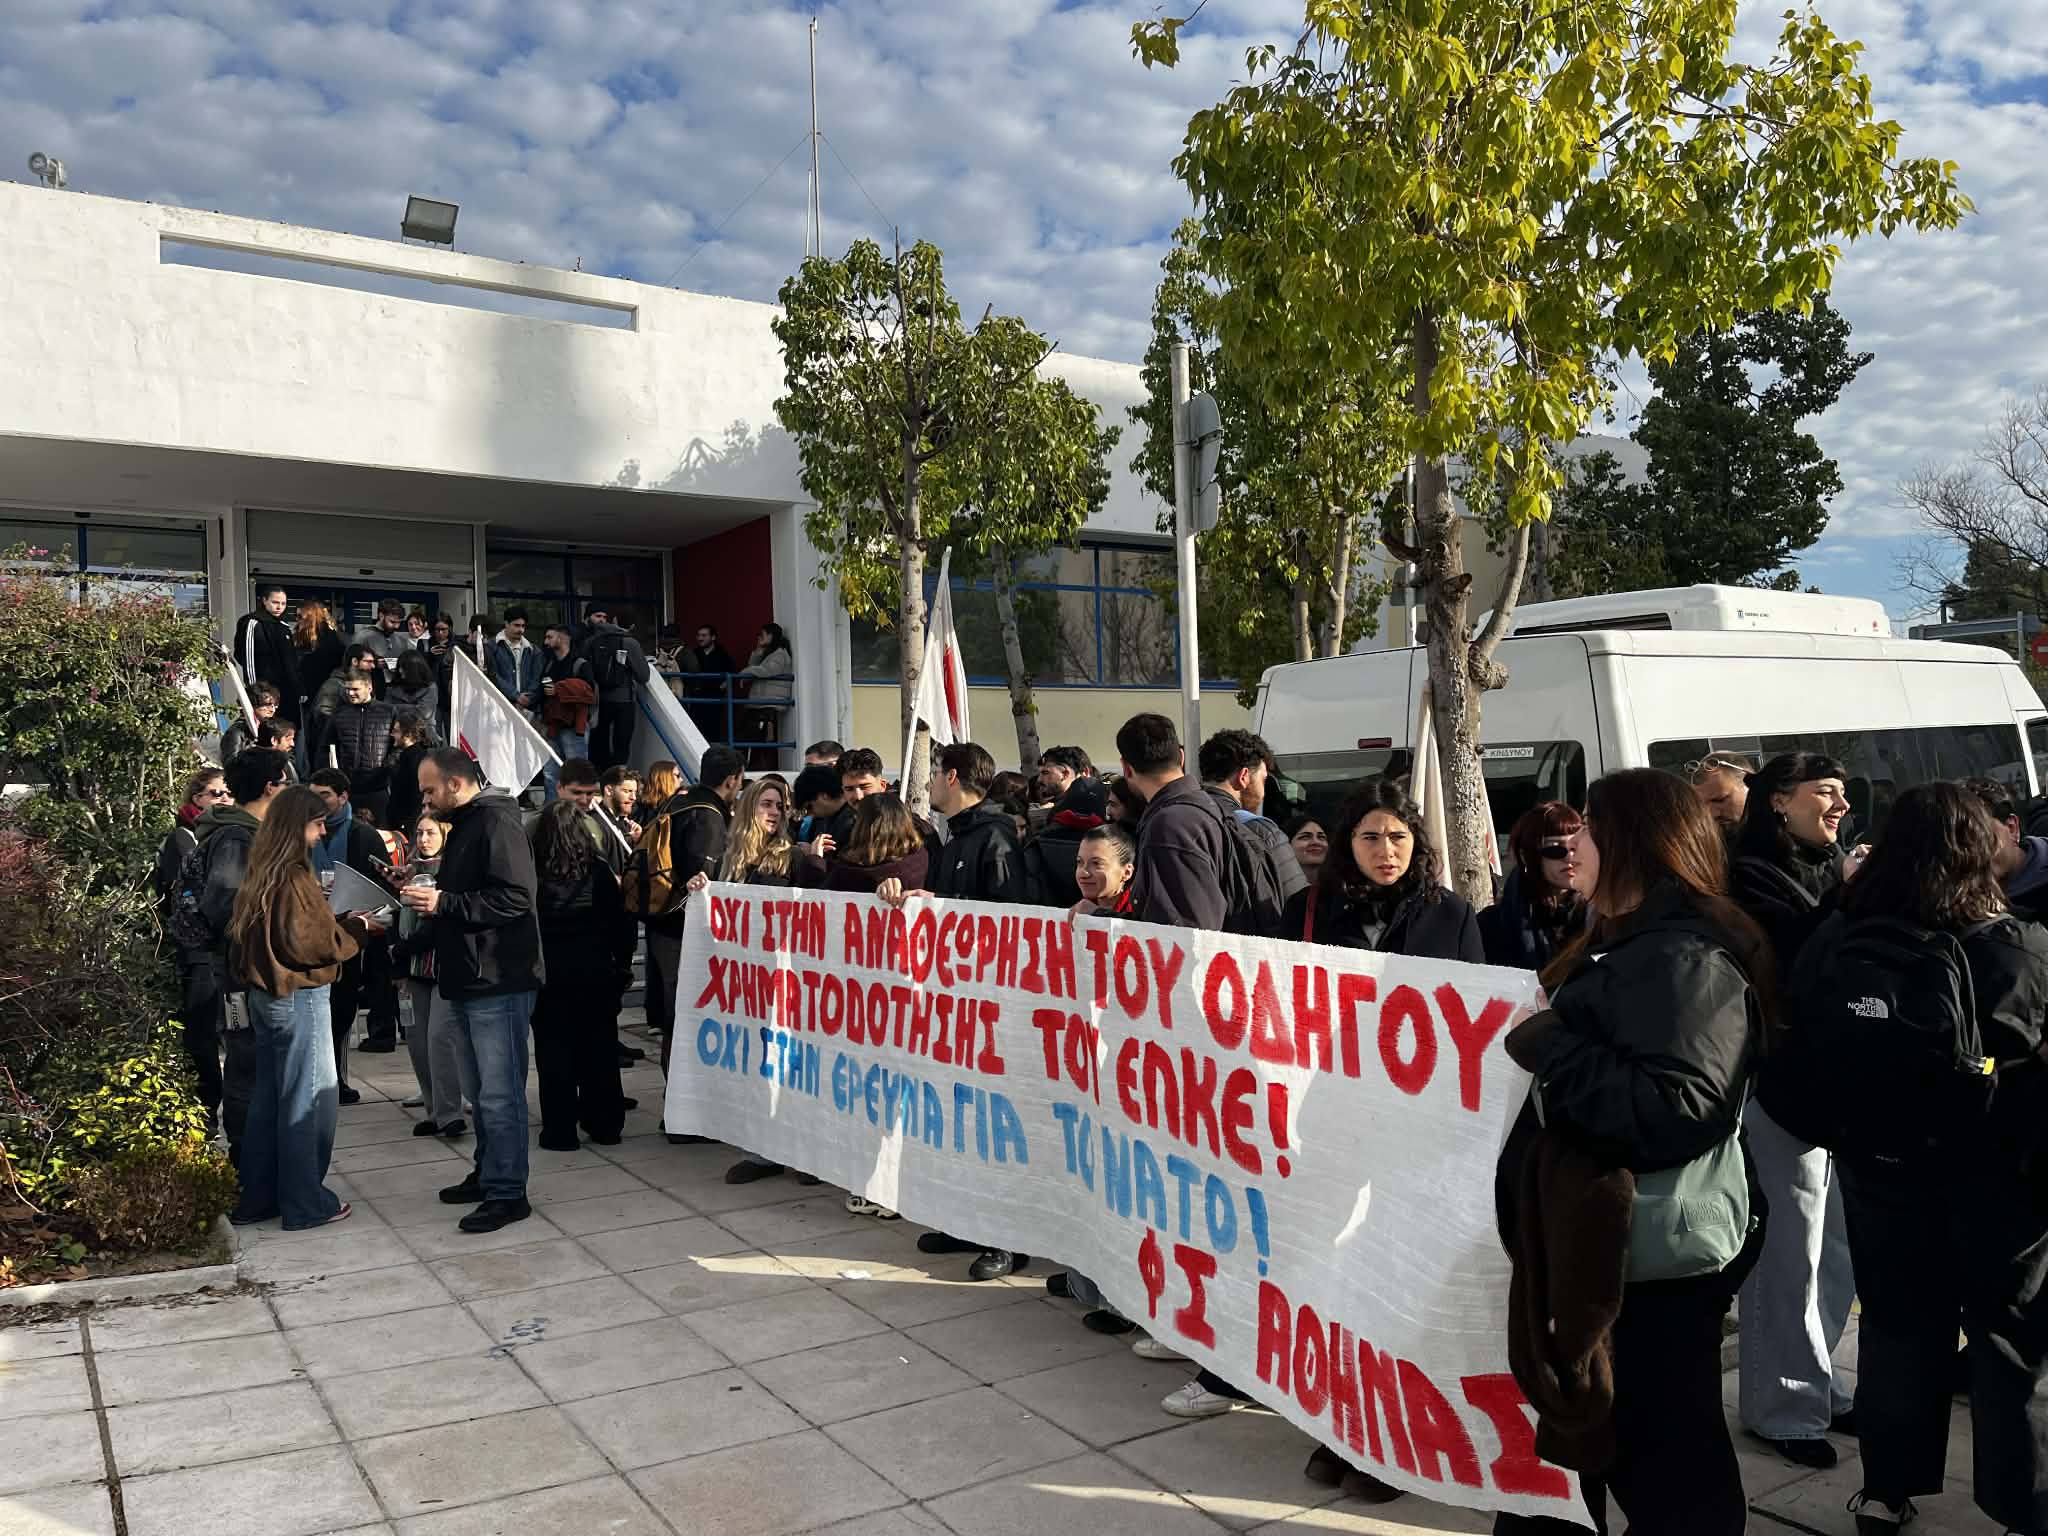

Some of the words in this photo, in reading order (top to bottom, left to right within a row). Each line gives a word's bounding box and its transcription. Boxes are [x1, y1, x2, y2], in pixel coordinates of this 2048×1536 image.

[694, 955, 1006, 1075] ΧΡΗΜΑΤΟΔΟΤΗΣΗΣ
[1032, 1008, 1100, 1106] ΤΟΥ
[711, 896, 749, 949] ΟΧΙ
[762, 901, 826, 961] ΣΤΗΝ
[844, 902, 1077, 1000] ΑΝΑΘΕΩΡΗΣΗ
[1086, 929, 1185, 1030] ΤΟΥ
[1202, 951, 1518, 1112] ΟΔΗΓΟΥ
[1848, 1002, 1876, 1010] NORTH
[1856, 1009, 1877, 1017] FACE
[696, 1018, 749, 1075] ΟΧΙ
[760, 1027, 821, 1098] ΣΤΗΝ
[832, 1051, 943, 1150] ΕΡΕΥΝΑ
[953, 1082, 1028, 1165] ΓΙΑ
[1052, 1102, 1095, 1192] ΤΟ
[1101, 1124, 1271, 1277] ΝΑΤΟ!
[1256, 1279, 1571, 1500] ΑΘΗΝΑΣ
